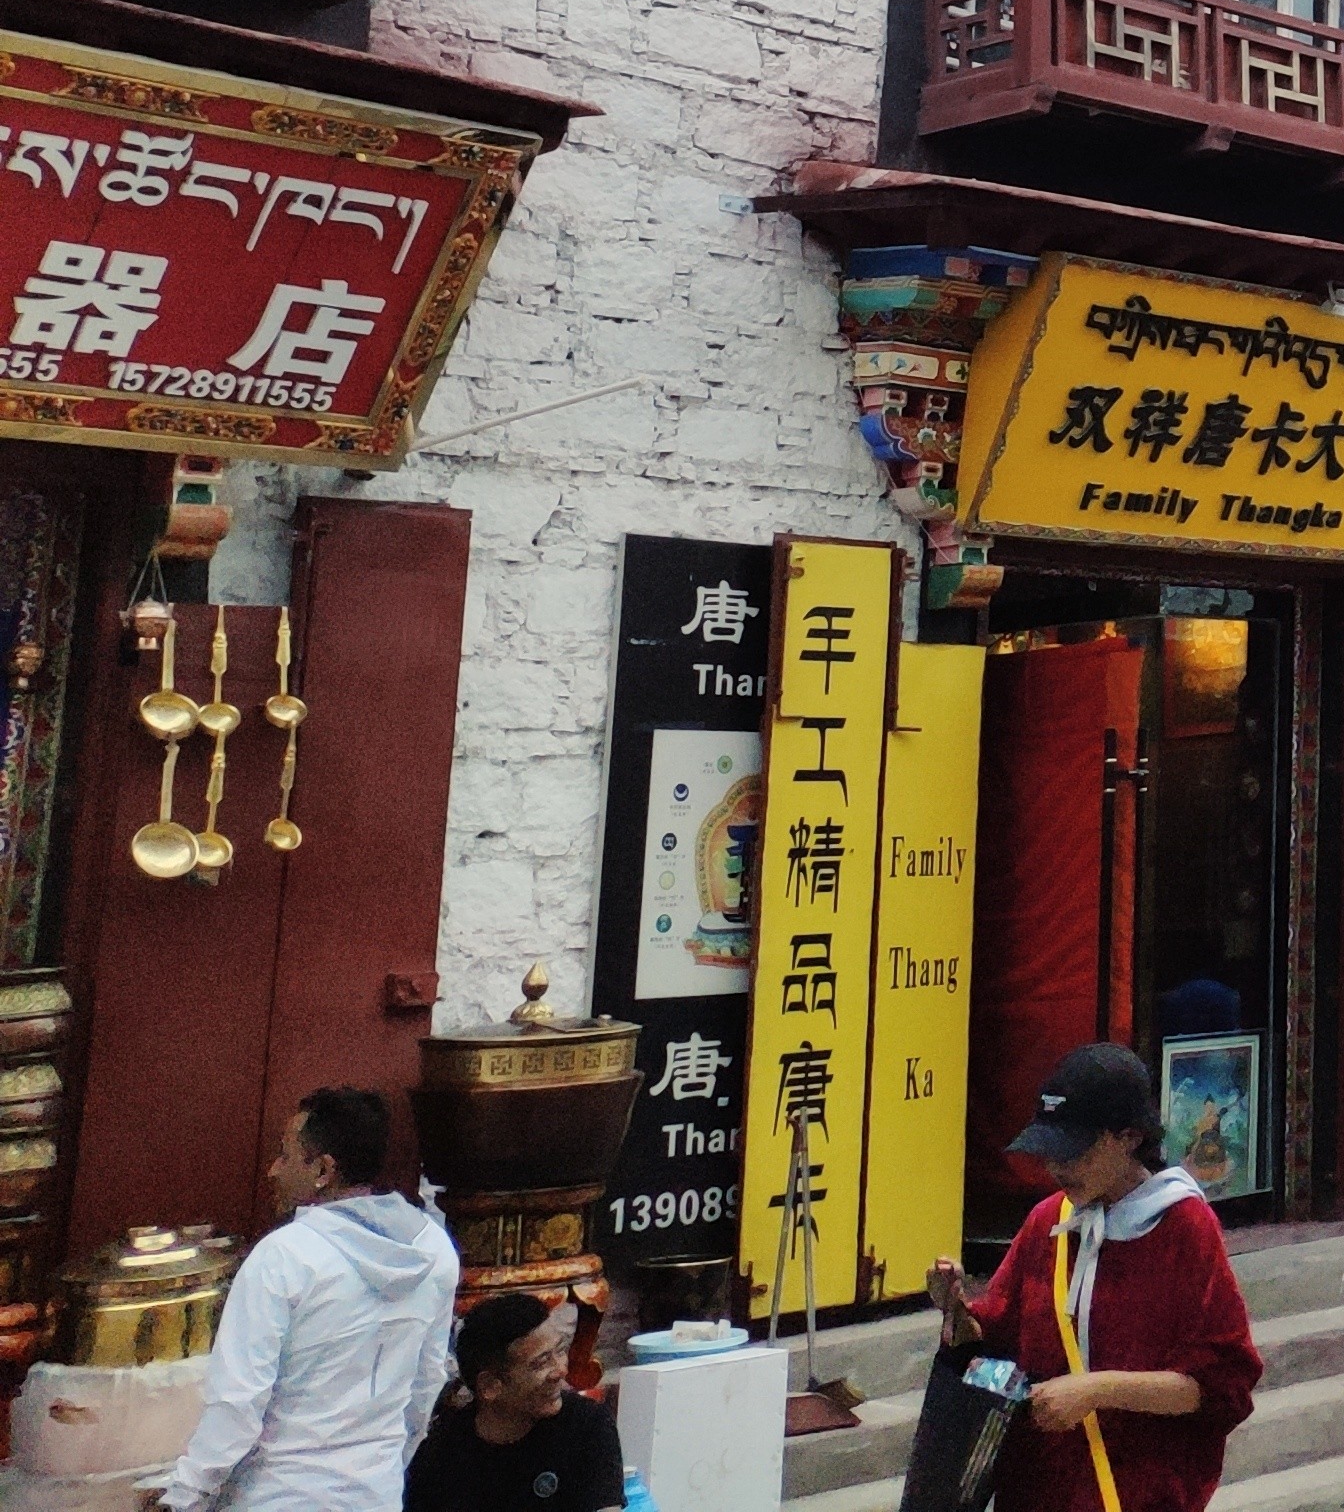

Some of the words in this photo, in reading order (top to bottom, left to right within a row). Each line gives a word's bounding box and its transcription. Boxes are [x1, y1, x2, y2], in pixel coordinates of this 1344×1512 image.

[108, 361, 337, 412] 15728911555
[1079, 483, 1199, 524] Family
[1219, 493, 1343, 533] Thangka
[680, 579, 760, 644] 唐
[889, 836, 967, 886] Family
[888, 946, 959, 995] Thang
[650, 1031, 733, 1101] 唐
[903, 1057, 934, 1102] Ka
